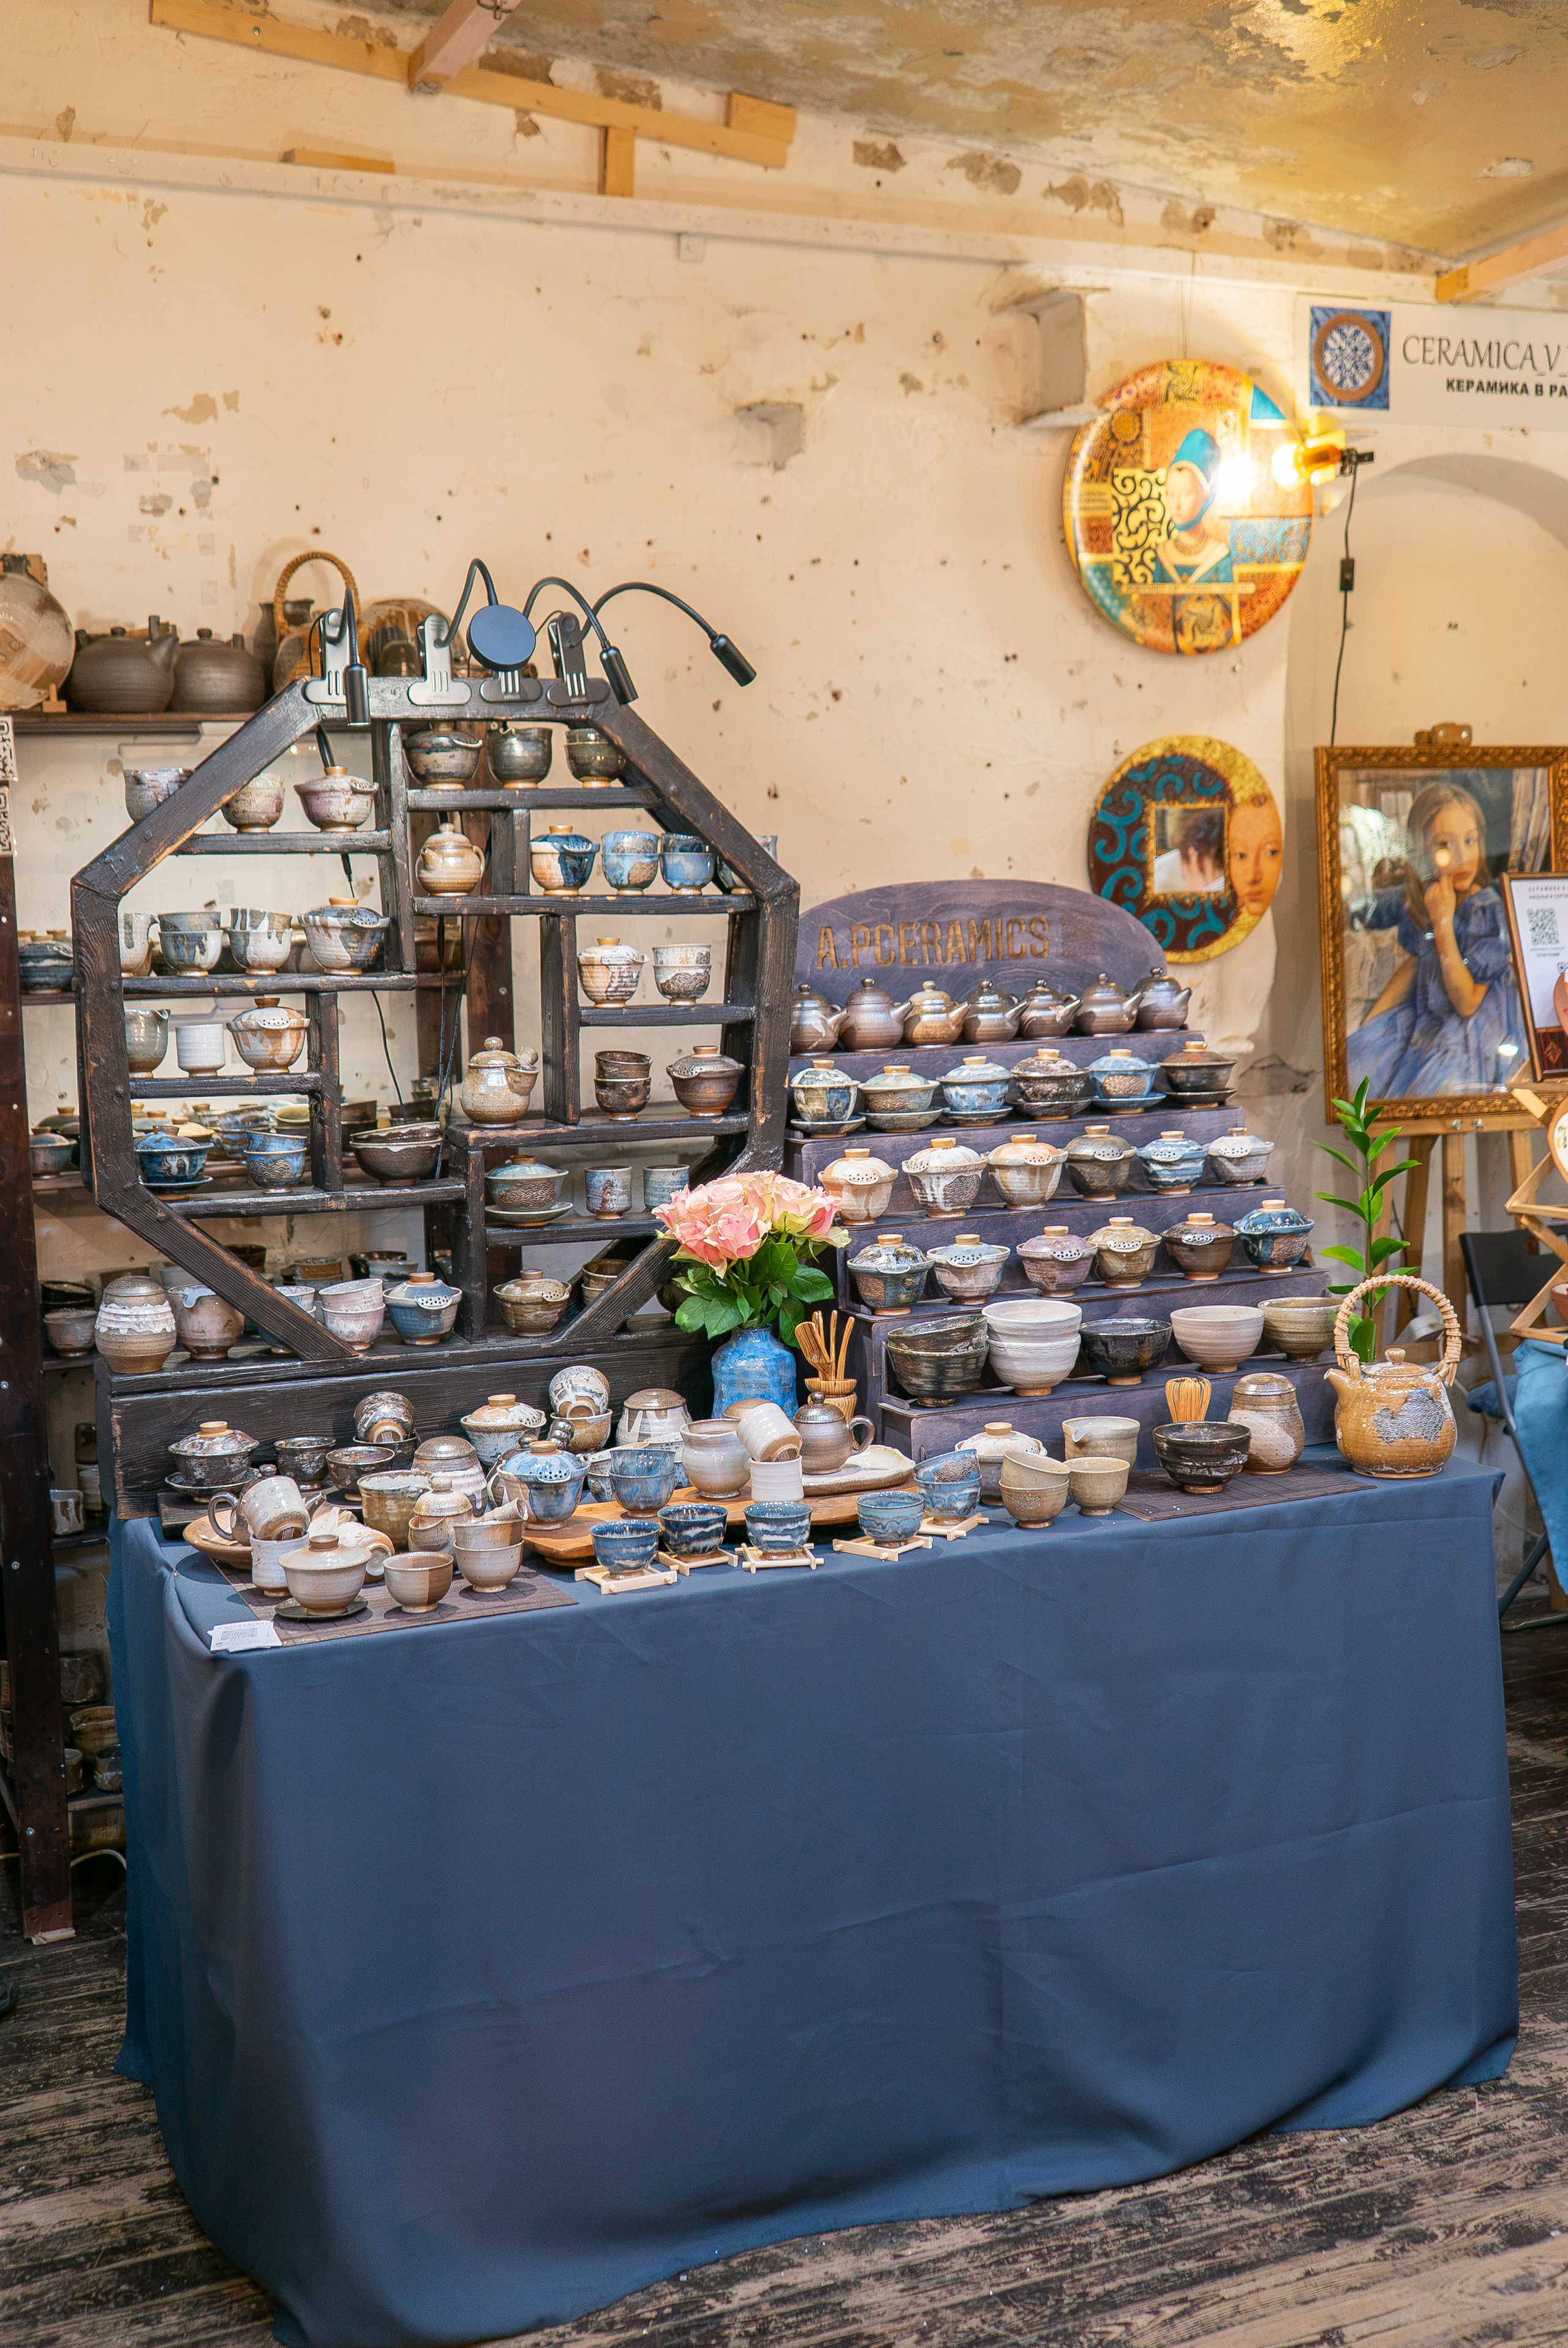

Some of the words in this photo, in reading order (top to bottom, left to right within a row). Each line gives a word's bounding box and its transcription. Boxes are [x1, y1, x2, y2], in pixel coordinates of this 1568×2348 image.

[1403, 334, 1568, 377] CERAMICA_V_
[1446, 377, 1529, 395] КЕРАМИКА
[1535, 383, 1544, 396] В
[1550, 384, 1568, 398] РА
